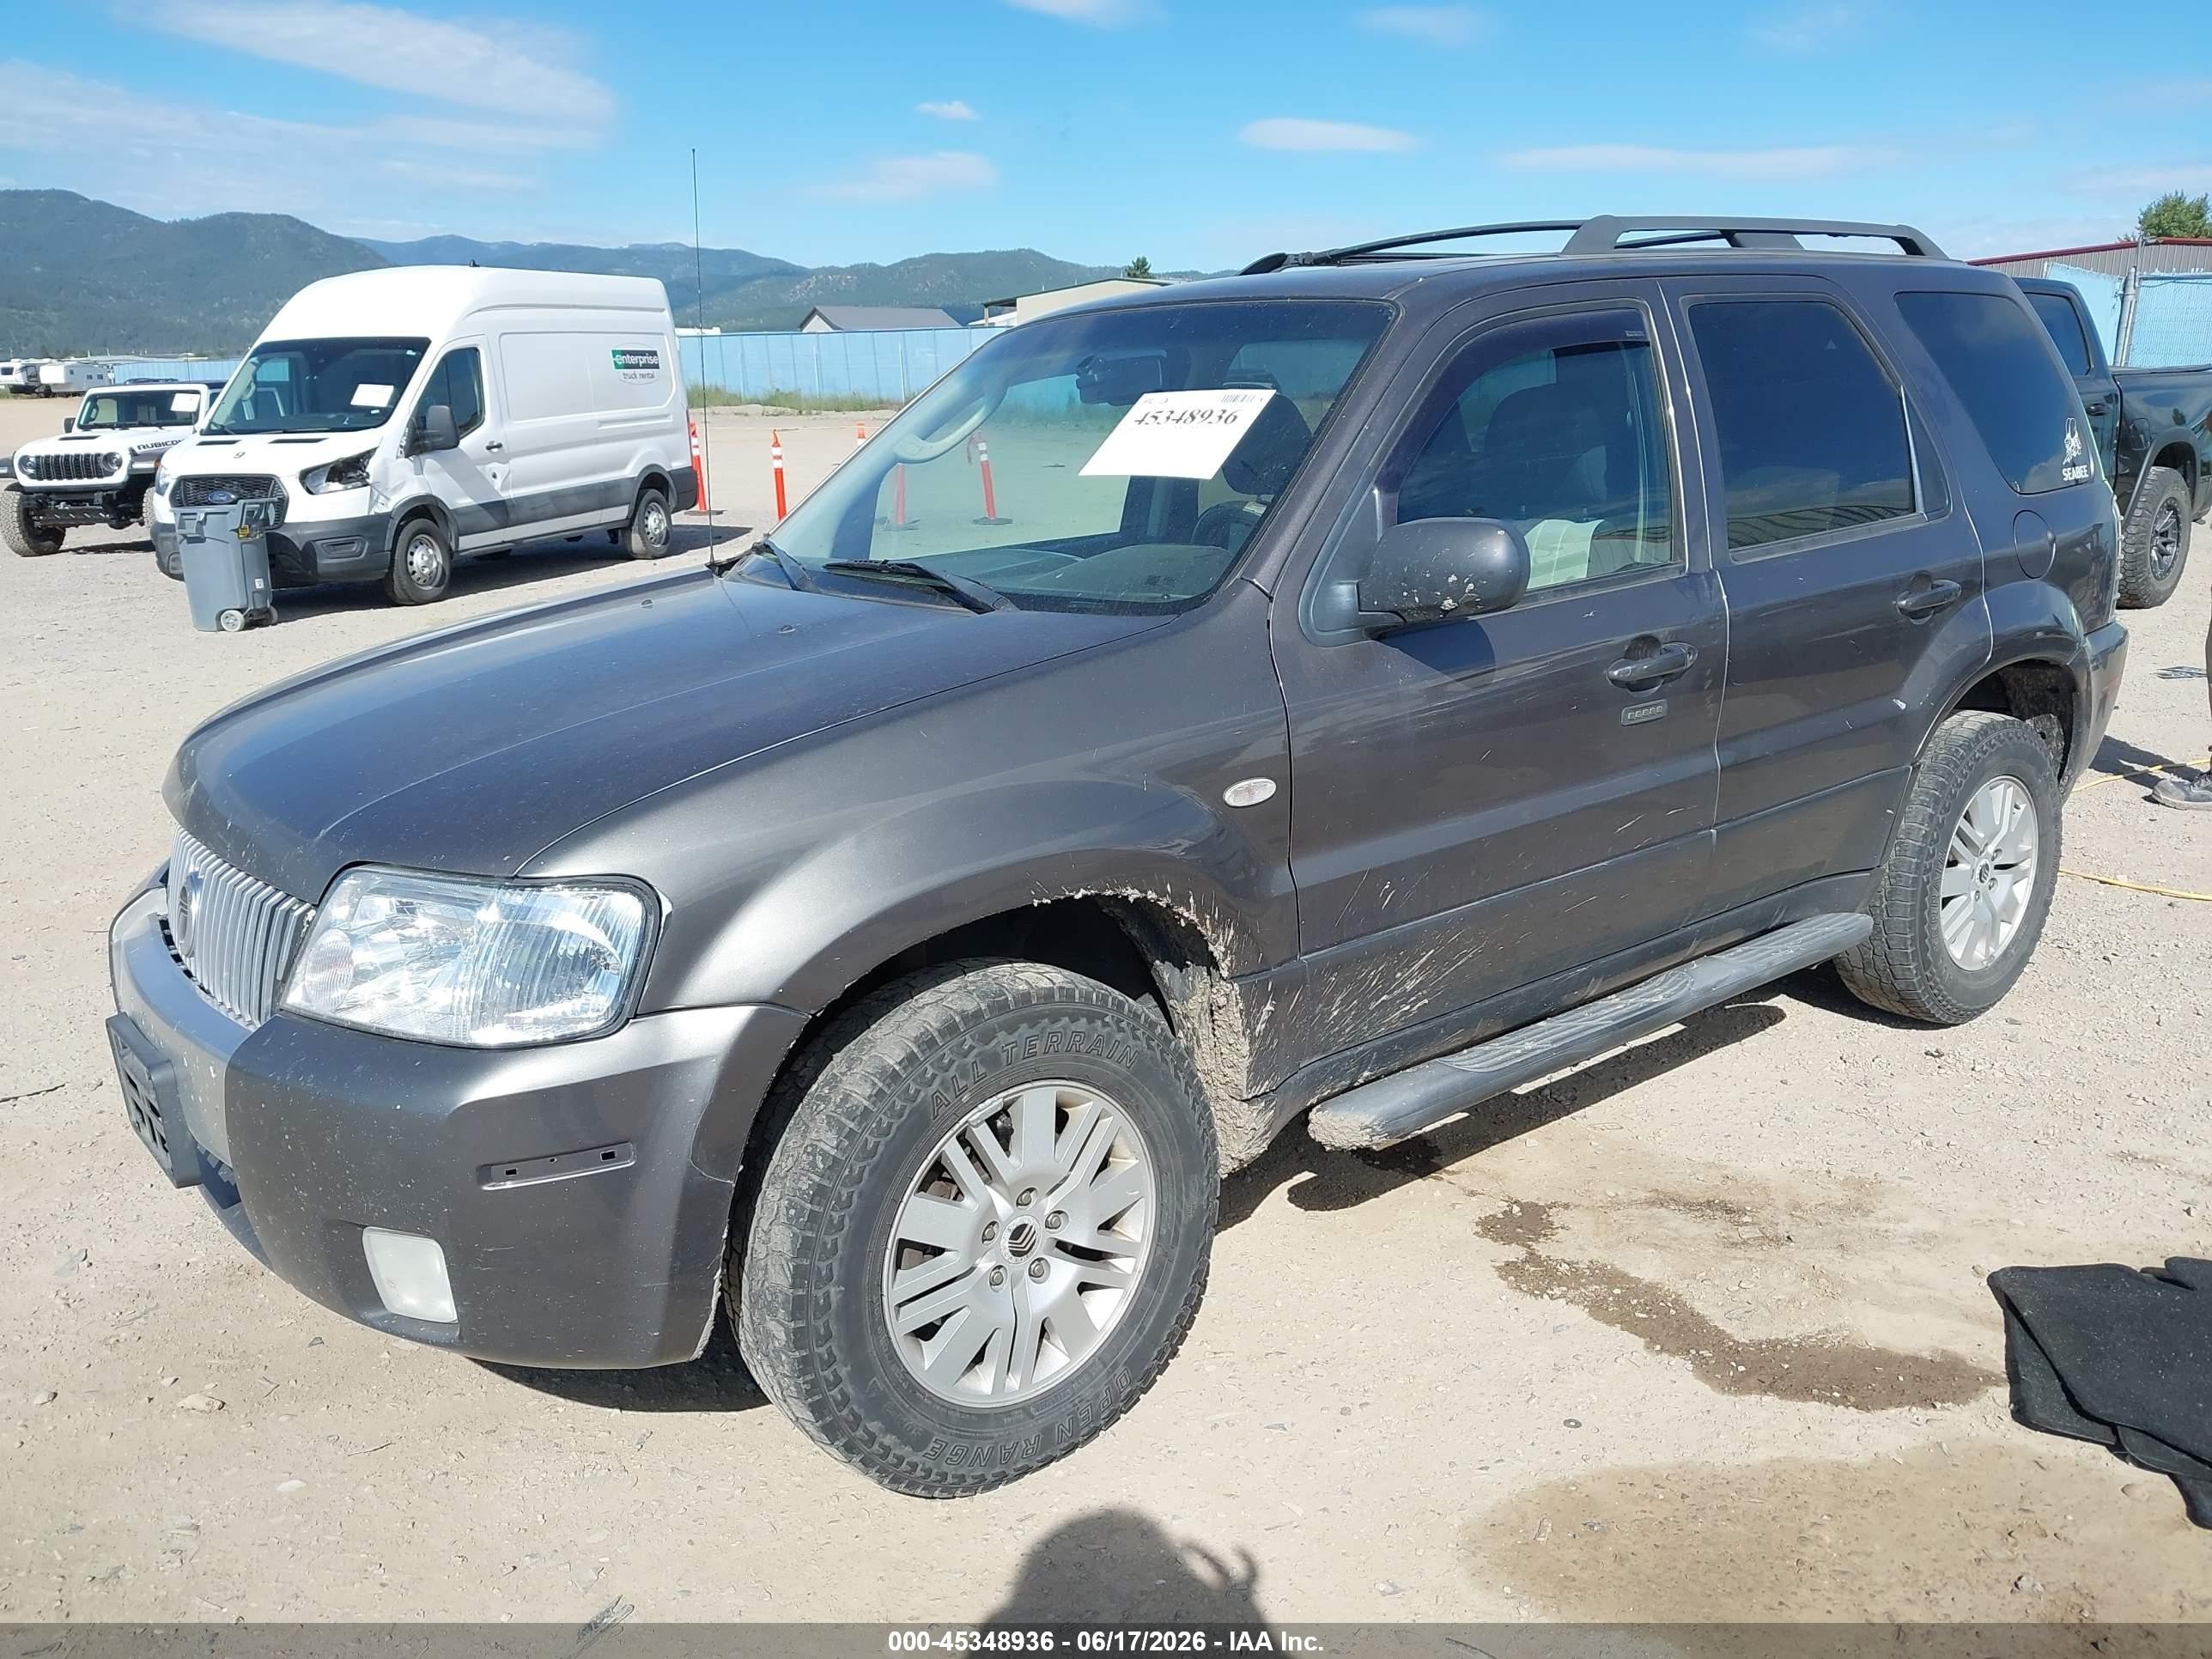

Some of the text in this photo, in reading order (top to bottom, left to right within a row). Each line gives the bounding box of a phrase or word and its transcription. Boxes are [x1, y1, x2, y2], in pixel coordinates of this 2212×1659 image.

[613, 352, 659, 368] enterprise
[1134, 408, 1243, 426] 45348936
[2062, 465, 2089, 481] SEABEE
[932, 1030, 1140, 1121] ALL TERRAIN
[1055, 1367, 1132, 1444] OPEN
[923, 1432, 1043, 1468] RANGE
